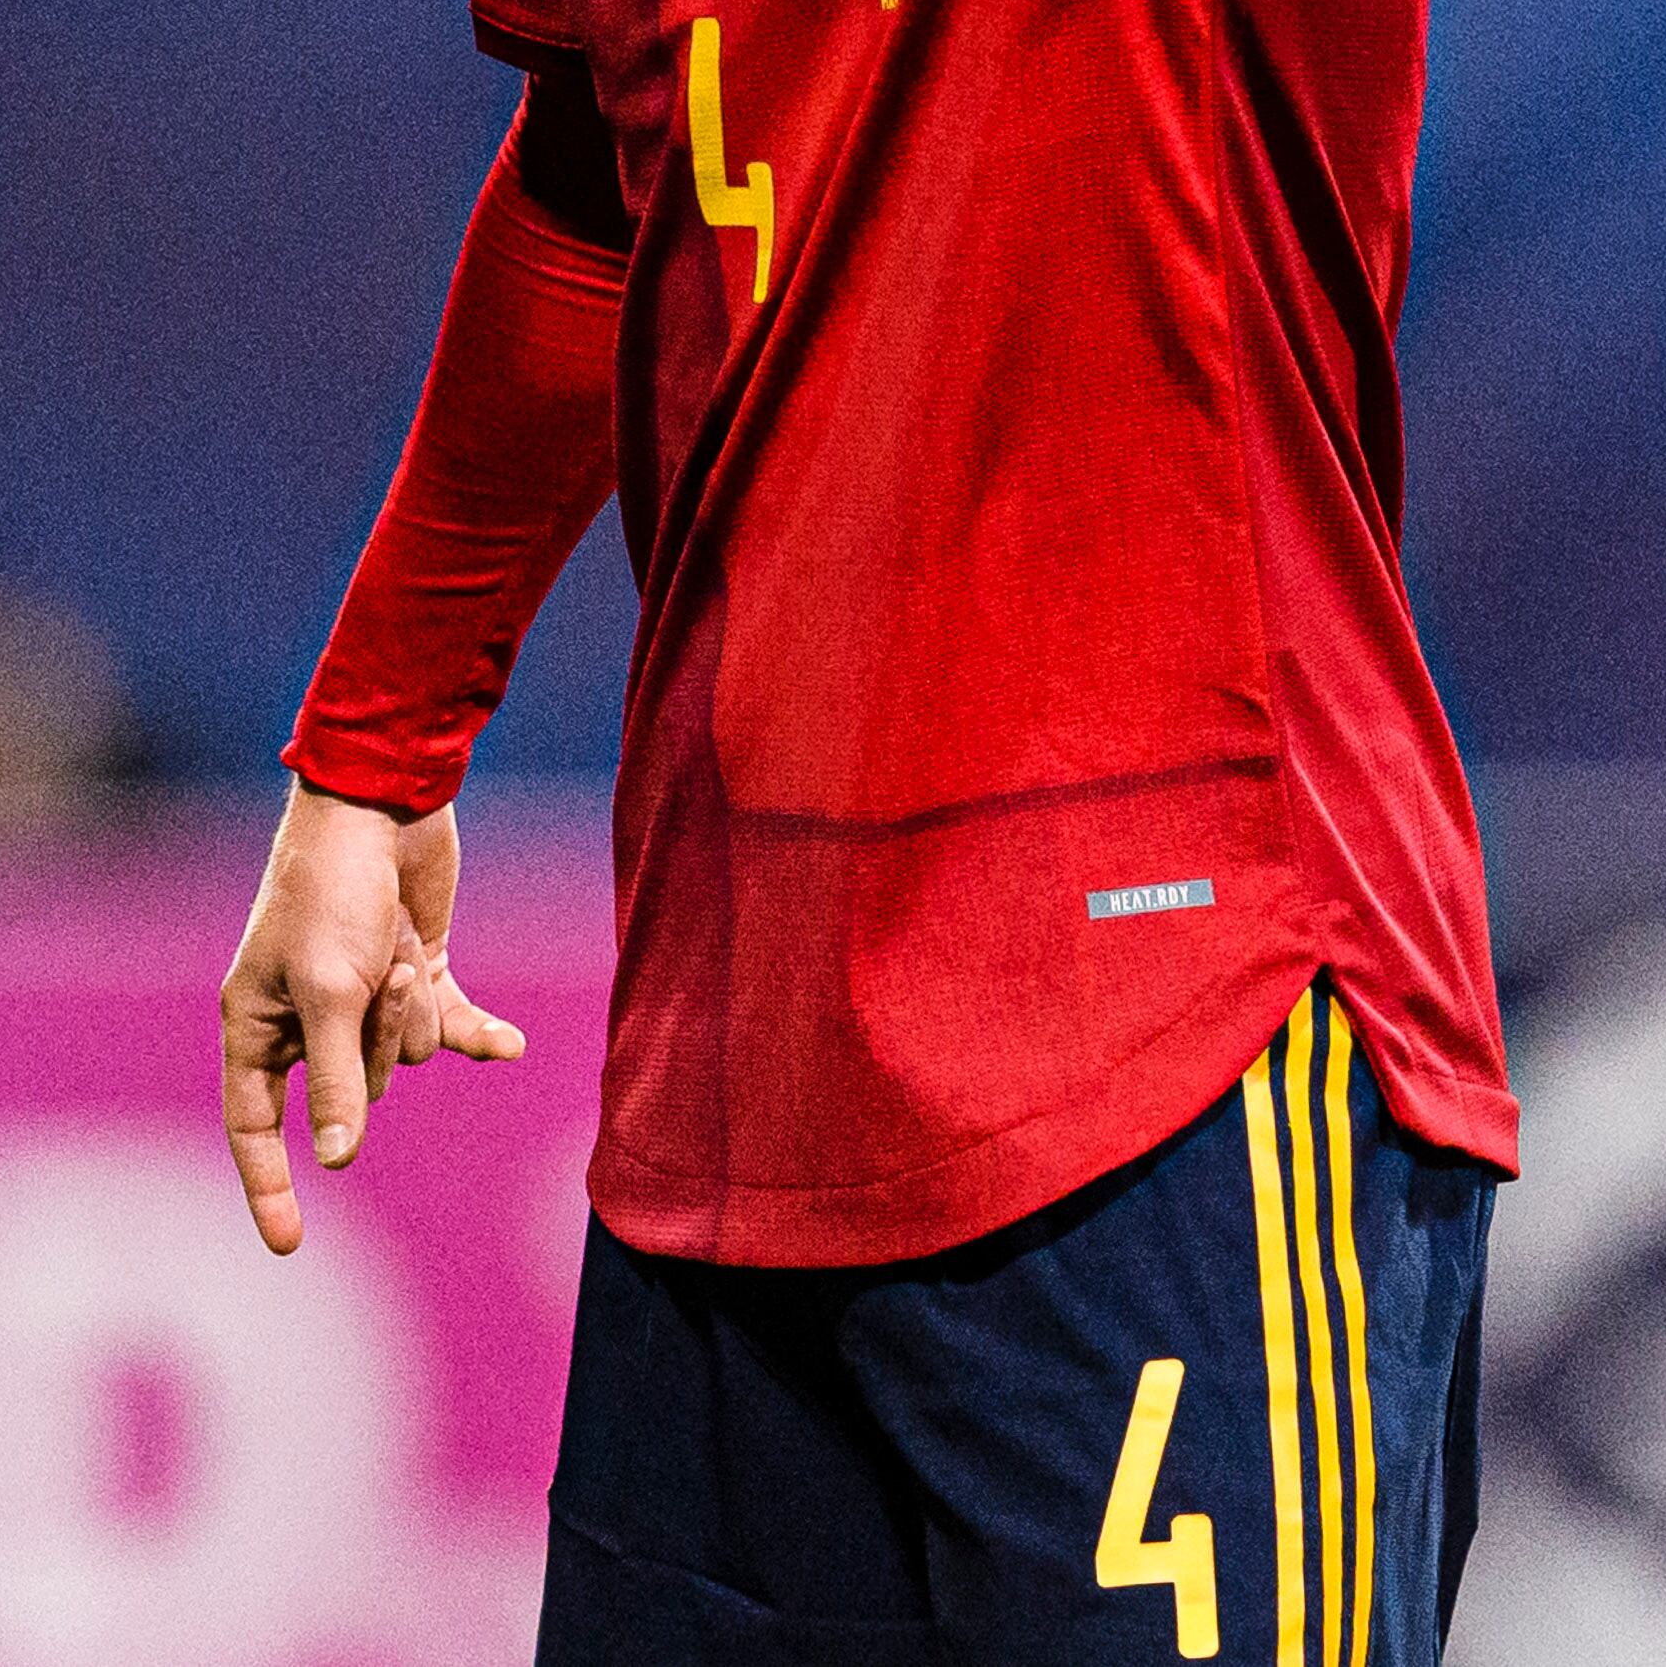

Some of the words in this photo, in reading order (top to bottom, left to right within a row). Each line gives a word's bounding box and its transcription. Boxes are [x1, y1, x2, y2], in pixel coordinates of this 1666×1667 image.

[687, 16, 775, 304] 4
[1109, 885, 1190, 913] HEAT.RDY
[1095, 1357, 1220, 1660] 4
